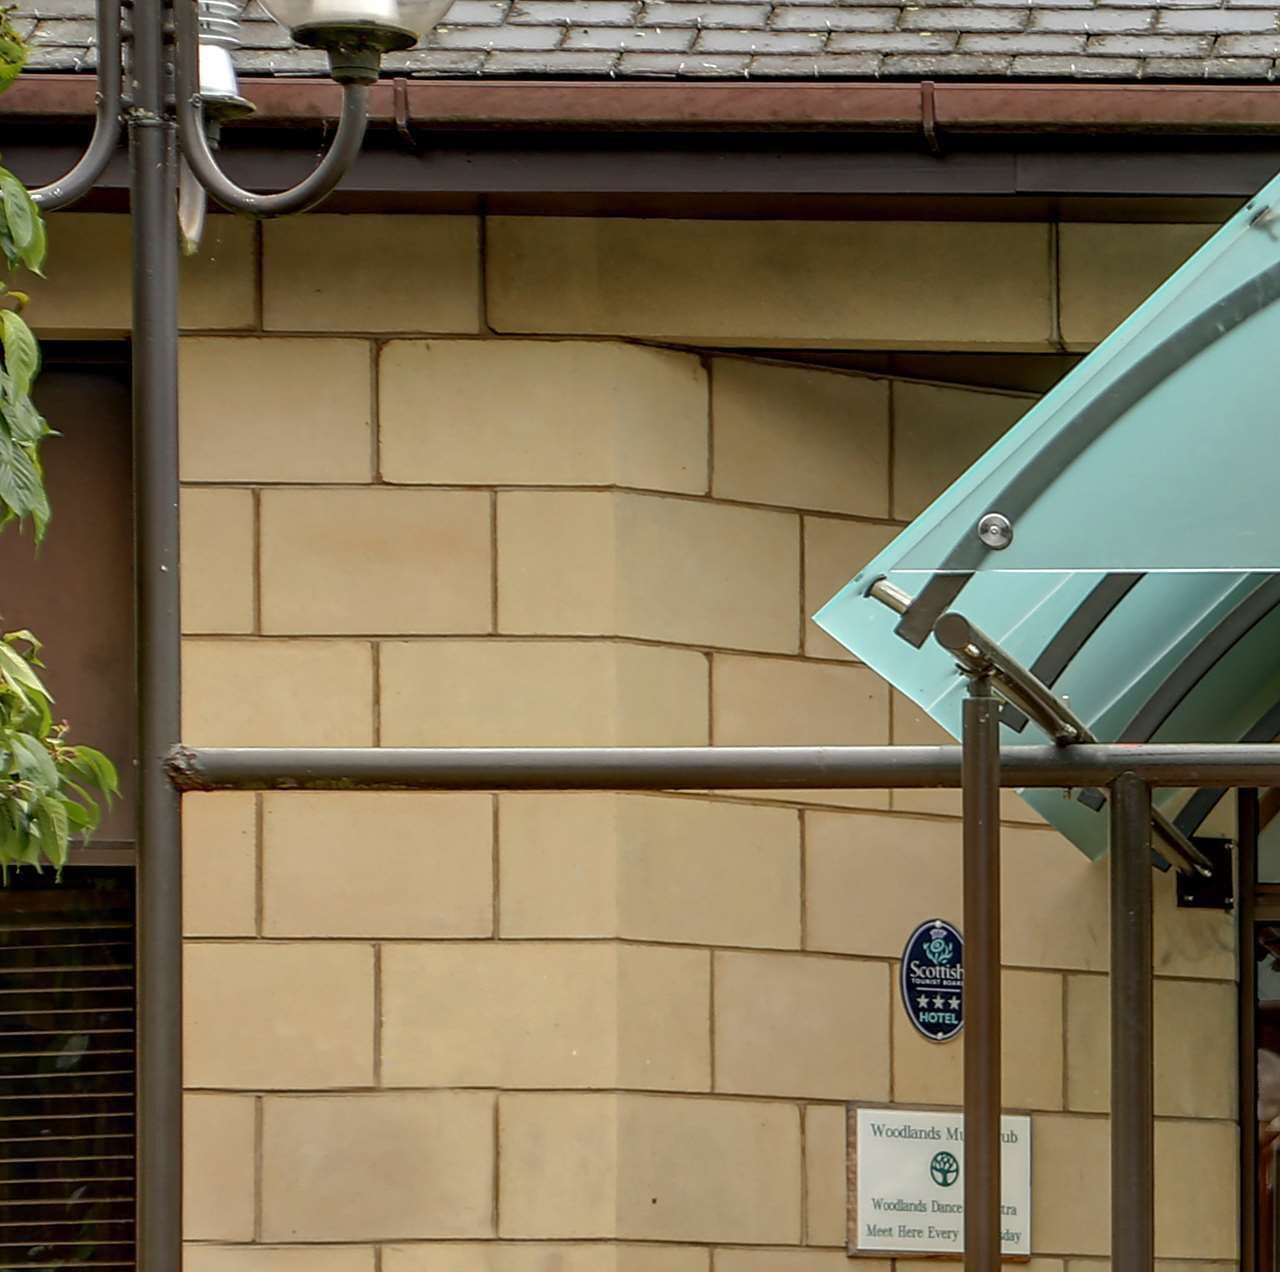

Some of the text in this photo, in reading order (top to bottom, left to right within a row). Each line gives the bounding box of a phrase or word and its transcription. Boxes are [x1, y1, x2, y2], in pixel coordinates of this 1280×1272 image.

[910, 960, 964, 980] Scottish
[919, 1012, 959, 1024] HOTEL
[871, 1123, 941, 1140] Woodlands
[872, 1198, 963, 1214] Woodlands Dance
[866, 1224, 960, 1241] Meet Here Every
